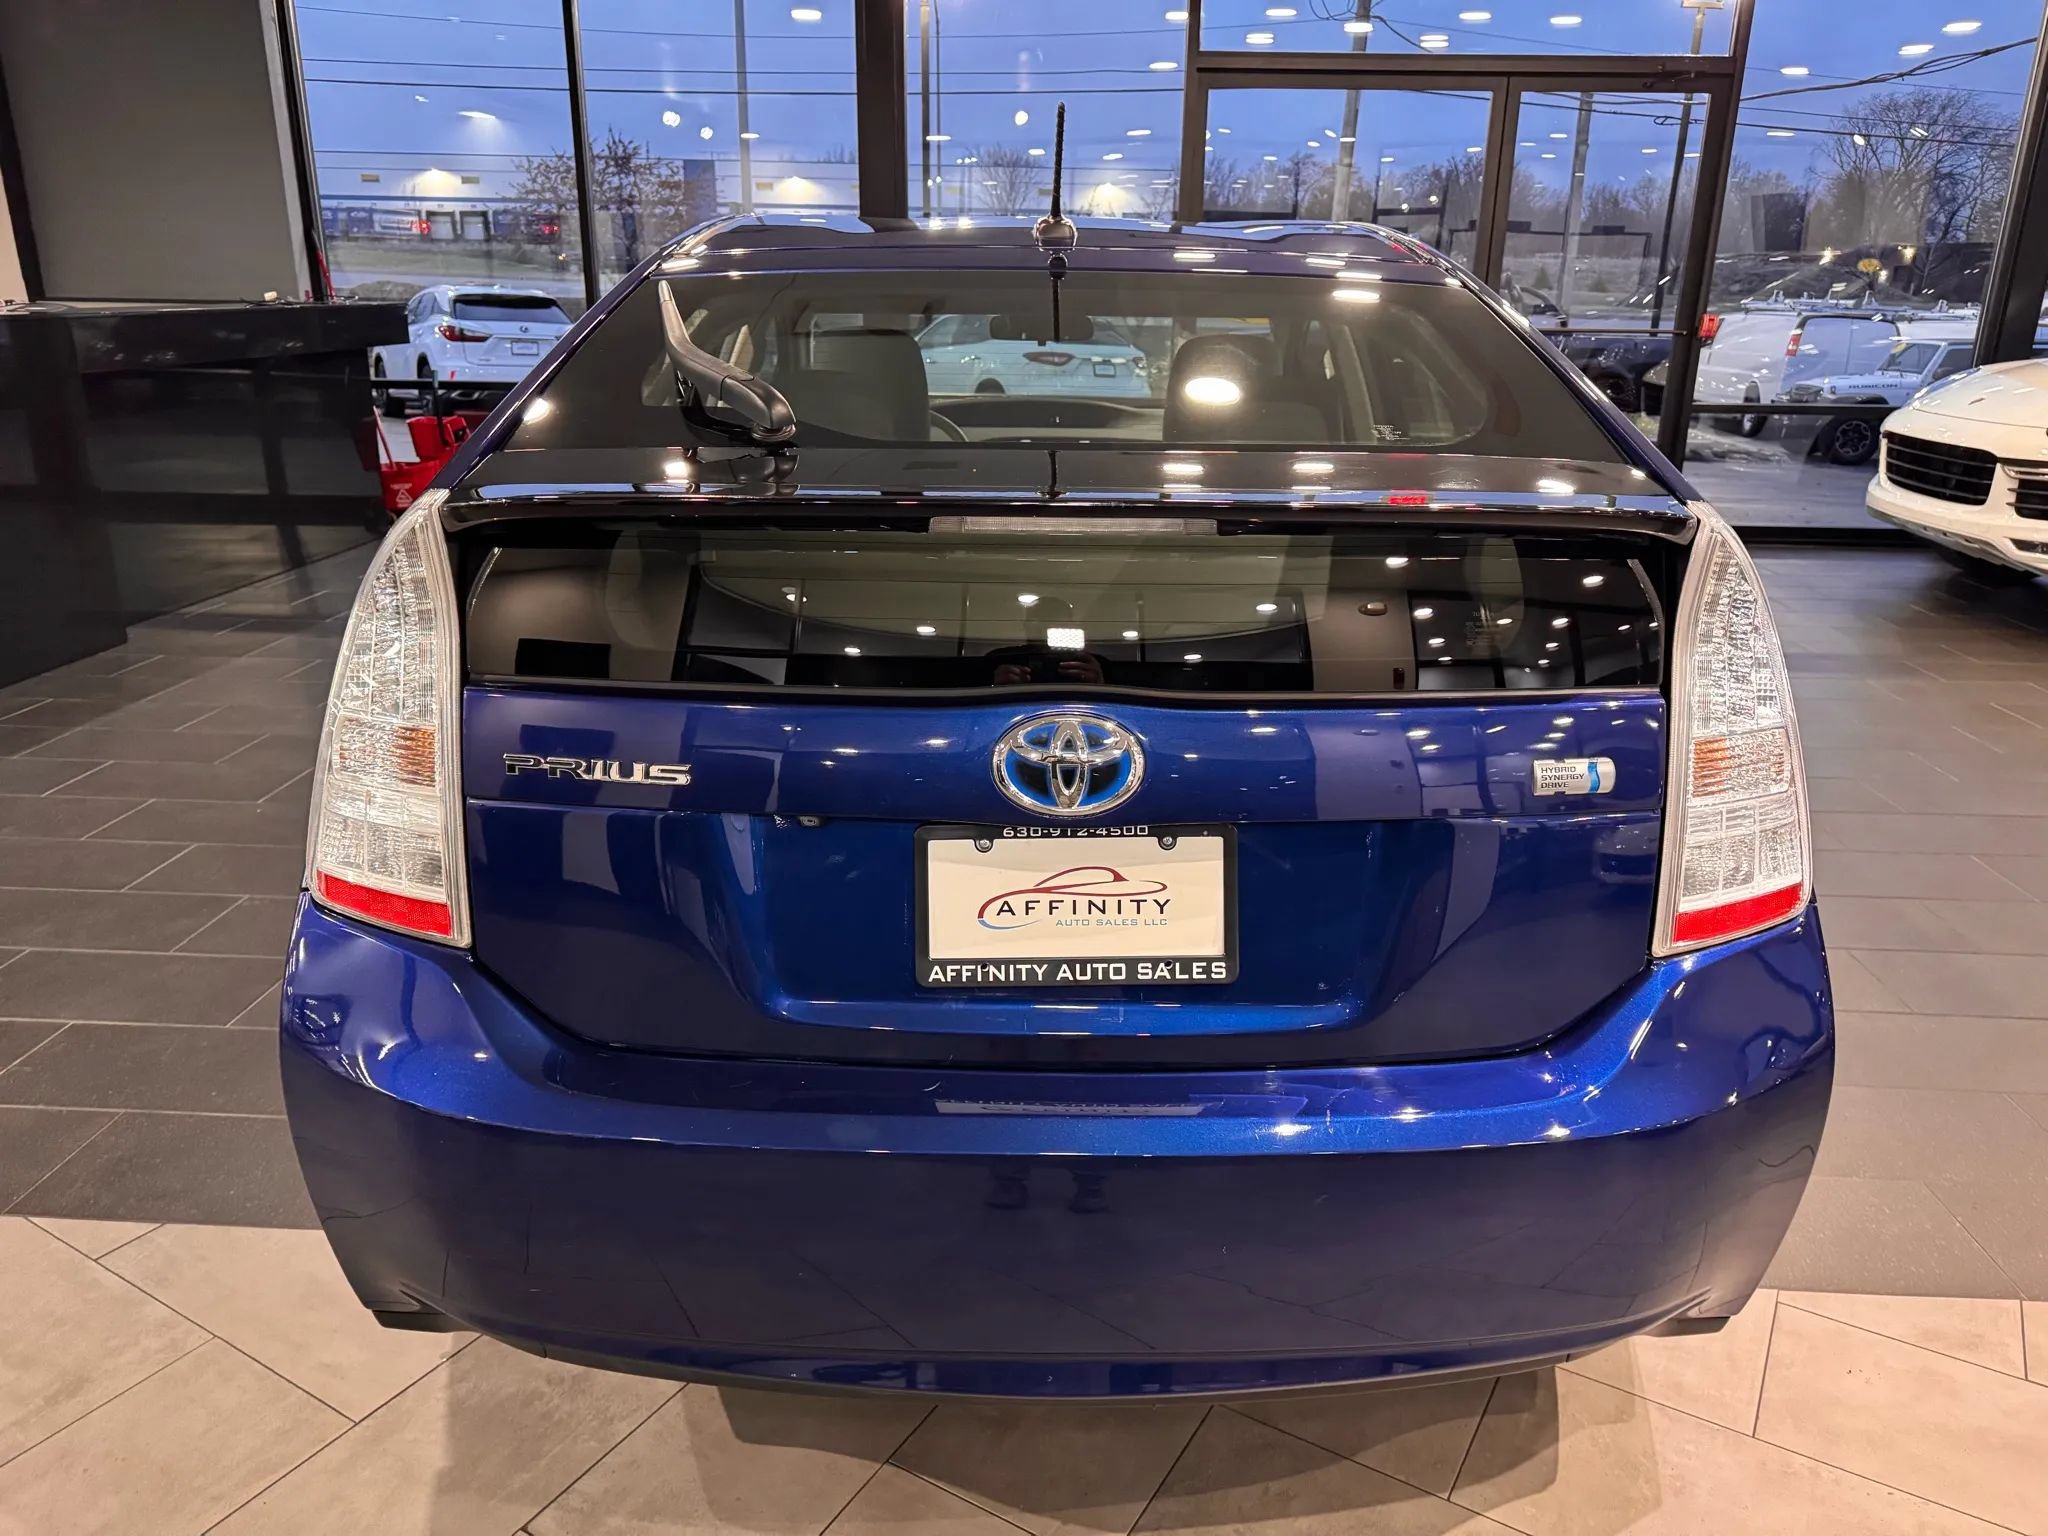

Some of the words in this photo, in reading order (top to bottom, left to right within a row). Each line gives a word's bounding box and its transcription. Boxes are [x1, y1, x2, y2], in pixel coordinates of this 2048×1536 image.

[503, 752, 692, 785] PRIUS
[1541, 773, 1585, 781] SYNERGY
[1541, 781, 1569, 789] DRIVE
[1002, 825, 1149, 837] 630-912-4500
[996, 898, 1171, 916] AFFINITY
[1055, 919, 1090, 927] AUTO
[1143, 918, 1168, 926] LLC
[928, 964, 1048, 982] AFFINITY
[1056, 963, 1126, 981] AUTO
[1137, 961, 1227, 980] SALES
